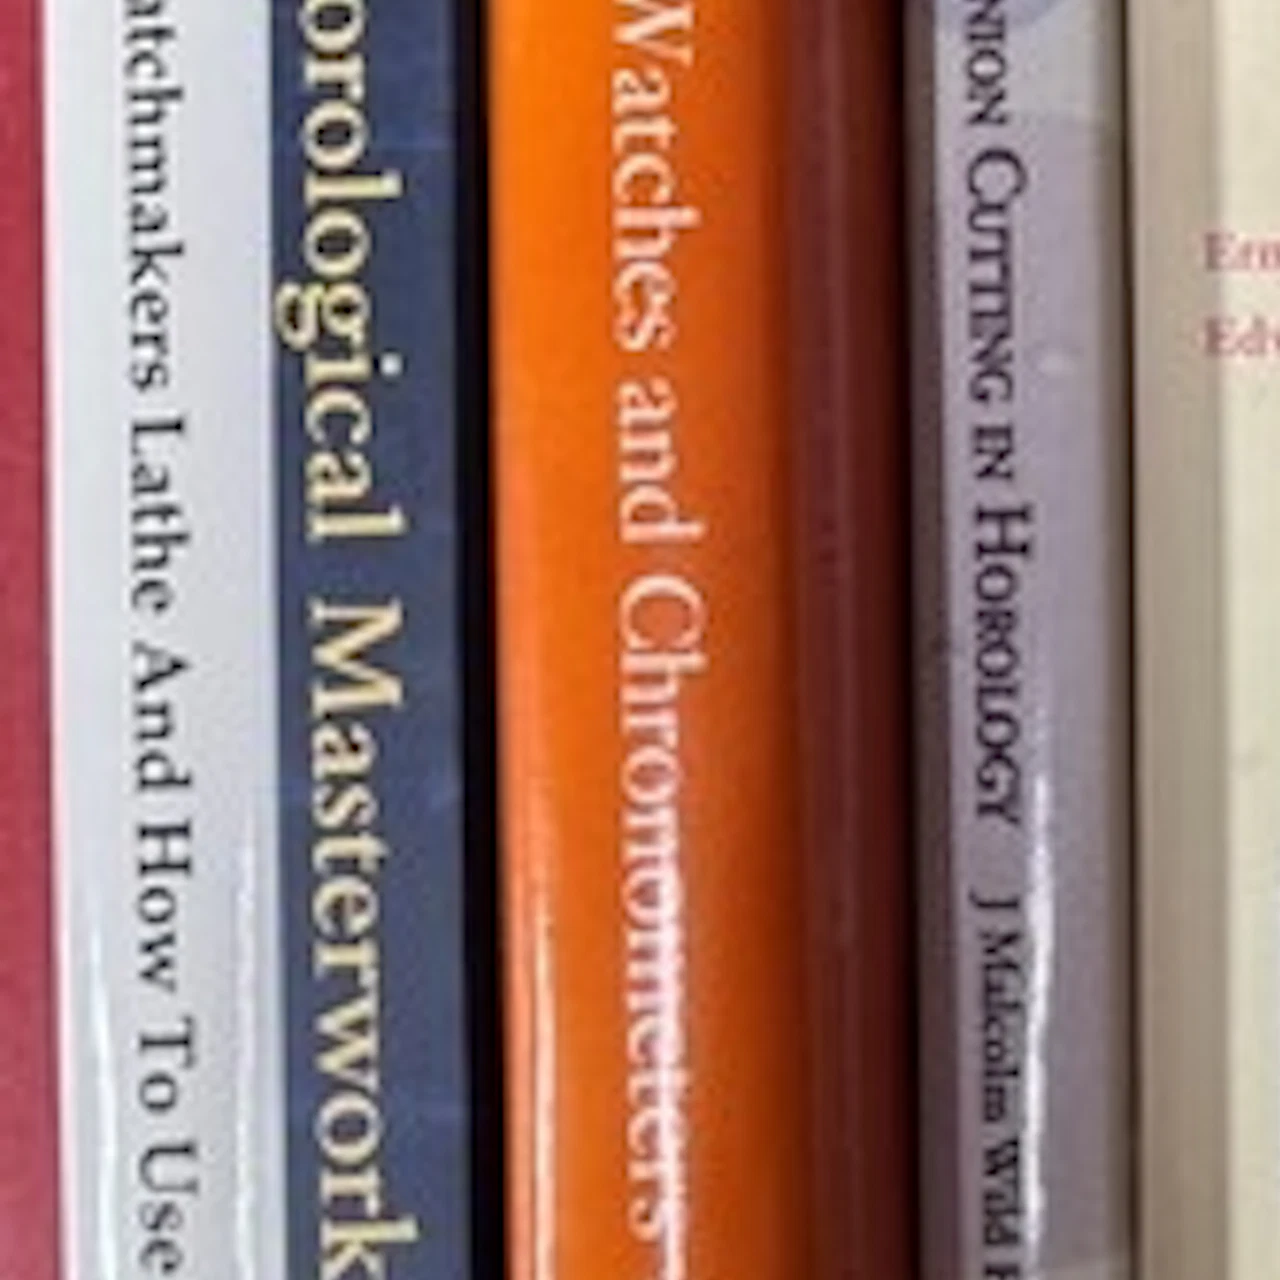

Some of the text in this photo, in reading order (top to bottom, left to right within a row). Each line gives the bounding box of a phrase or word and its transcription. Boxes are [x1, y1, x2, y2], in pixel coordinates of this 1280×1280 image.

[130, 414, 191, 614] Lathe
[617, 382, 704, 544] and
[131, 642, 192, 794] And
[136, 825, 192, 993] How
[619, 574, 706, 1242] Chronometers
[969, 889, 1020, 913] J
[137, 1018, 196, 1114] To
[980, 930, 1027, 1126] Malcolm
[138, 1141, 199, 1277] Use
[983, 1134, 1028, 1248] Wild
